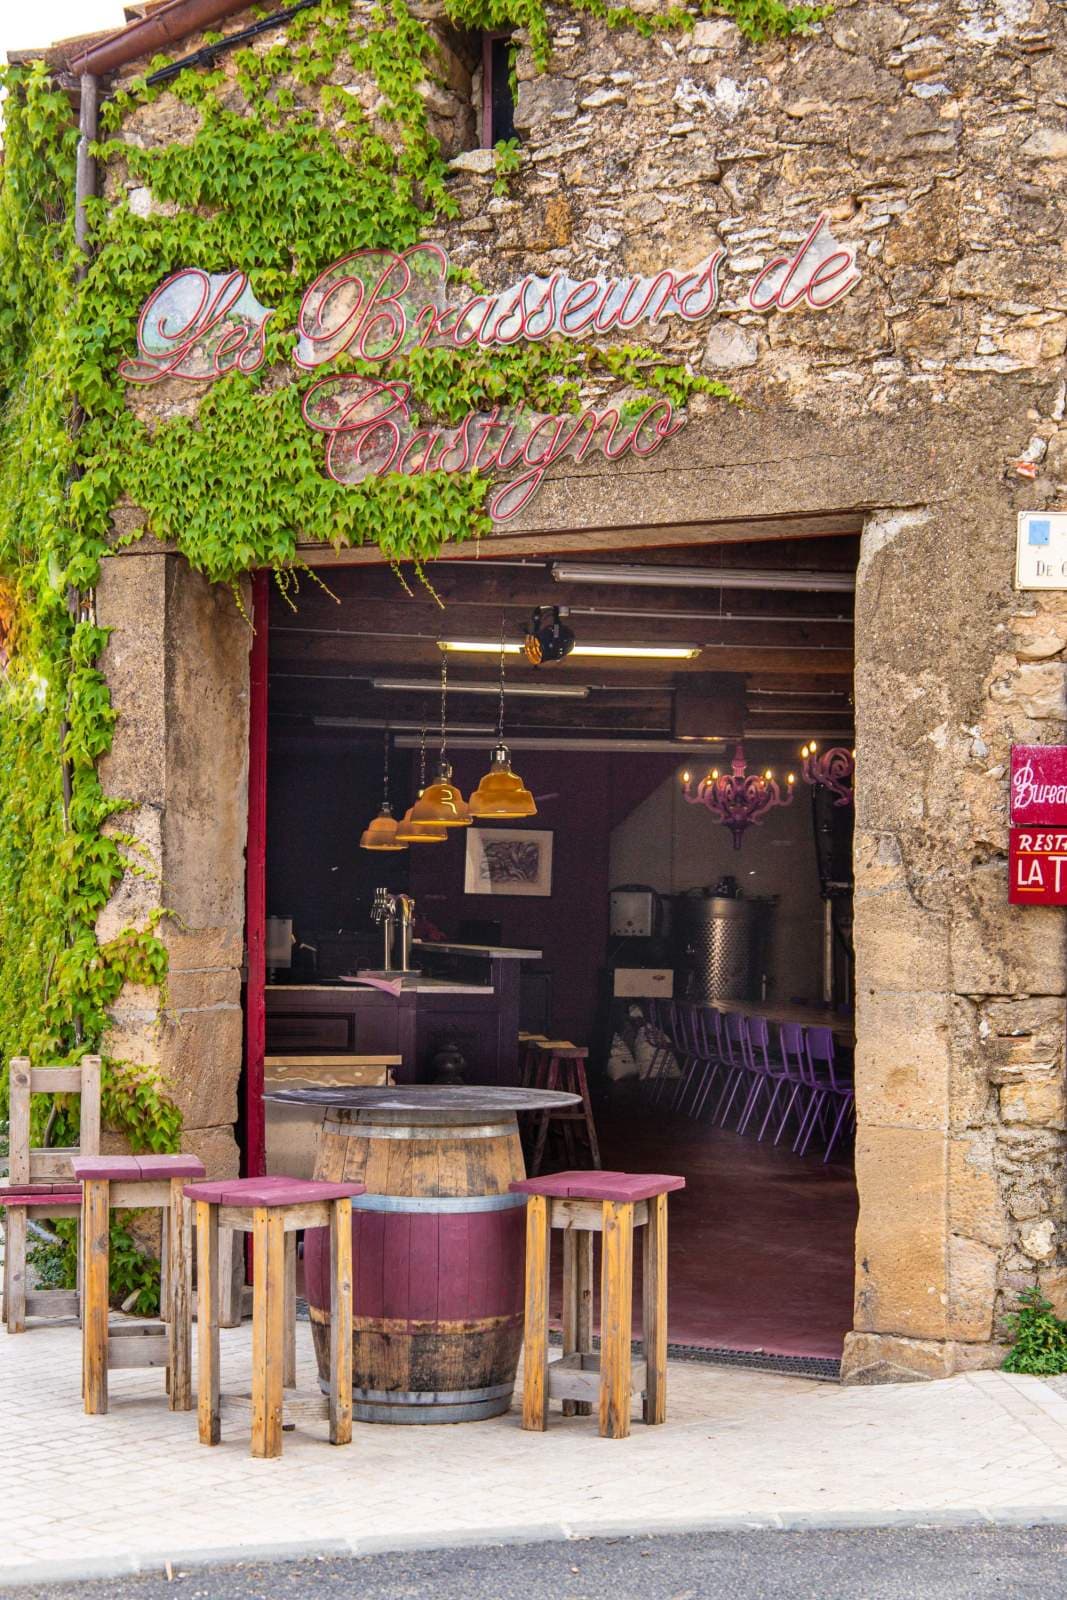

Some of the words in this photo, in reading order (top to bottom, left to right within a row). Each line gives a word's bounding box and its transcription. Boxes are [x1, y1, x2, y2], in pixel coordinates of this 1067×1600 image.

[117, 267, 274, 383] Les
[291, 243, 726, 370] Brasseurs
[748, 211, 861, 311] de
[301, 373, 687, 522] Castigno
[1013, 759, 1067, 809] Burea
[1017, 858, 1044, 886] LA
